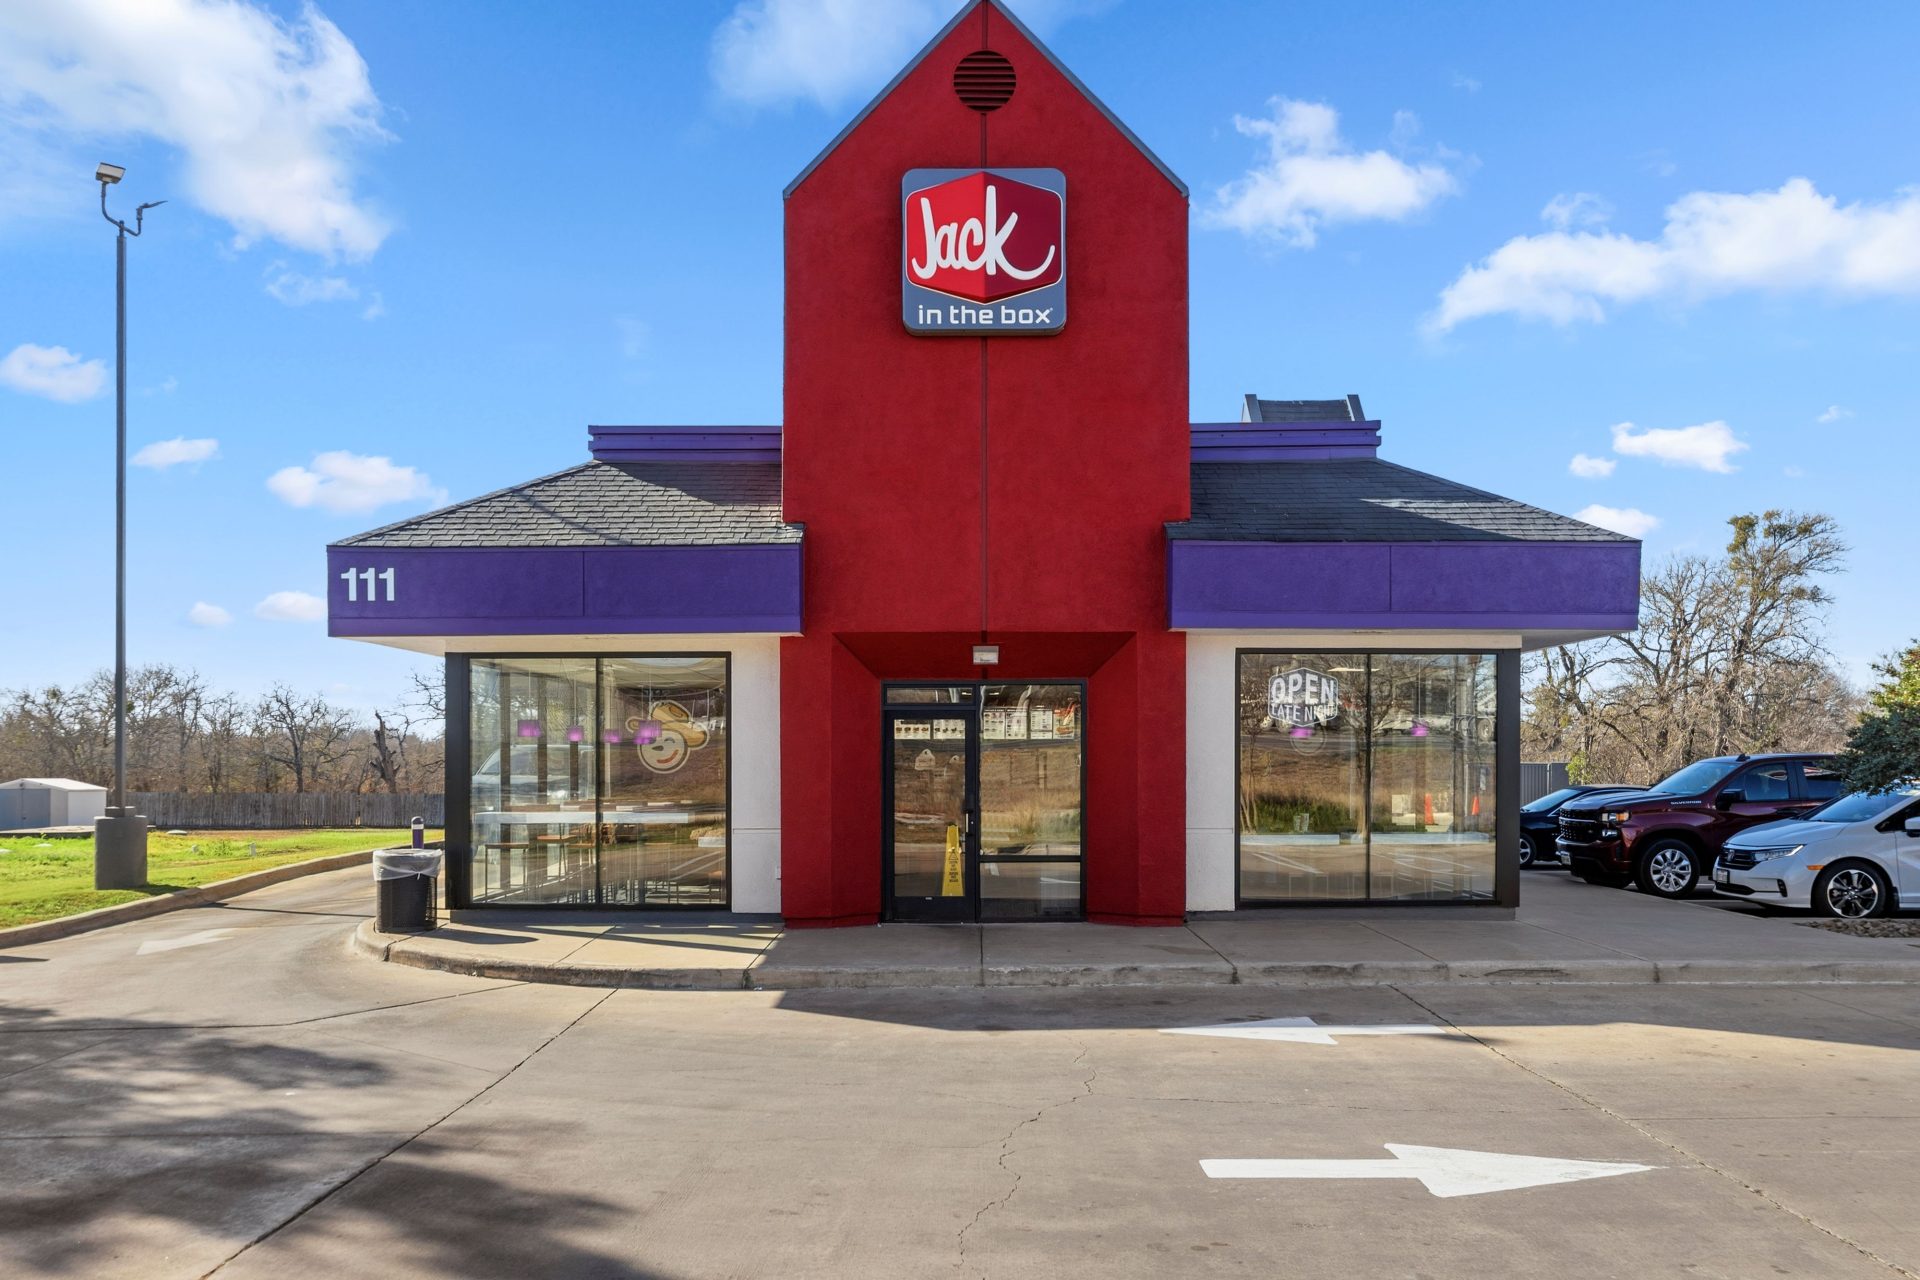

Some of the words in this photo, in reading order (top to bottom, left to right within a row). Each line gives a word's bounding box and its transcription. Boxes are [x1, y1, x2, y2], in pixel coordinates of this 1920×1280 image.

[911, 185, 1056, 281] Jack
[918, 304, 942, 325] in
[949, 305, 994, 325] the
[1001, 305, 1051, 324] box
[340, 567, 395, 602] 111
[1270, 673, 1335, 705] OPEN
[1270, 703, 1302, 722] LATE
